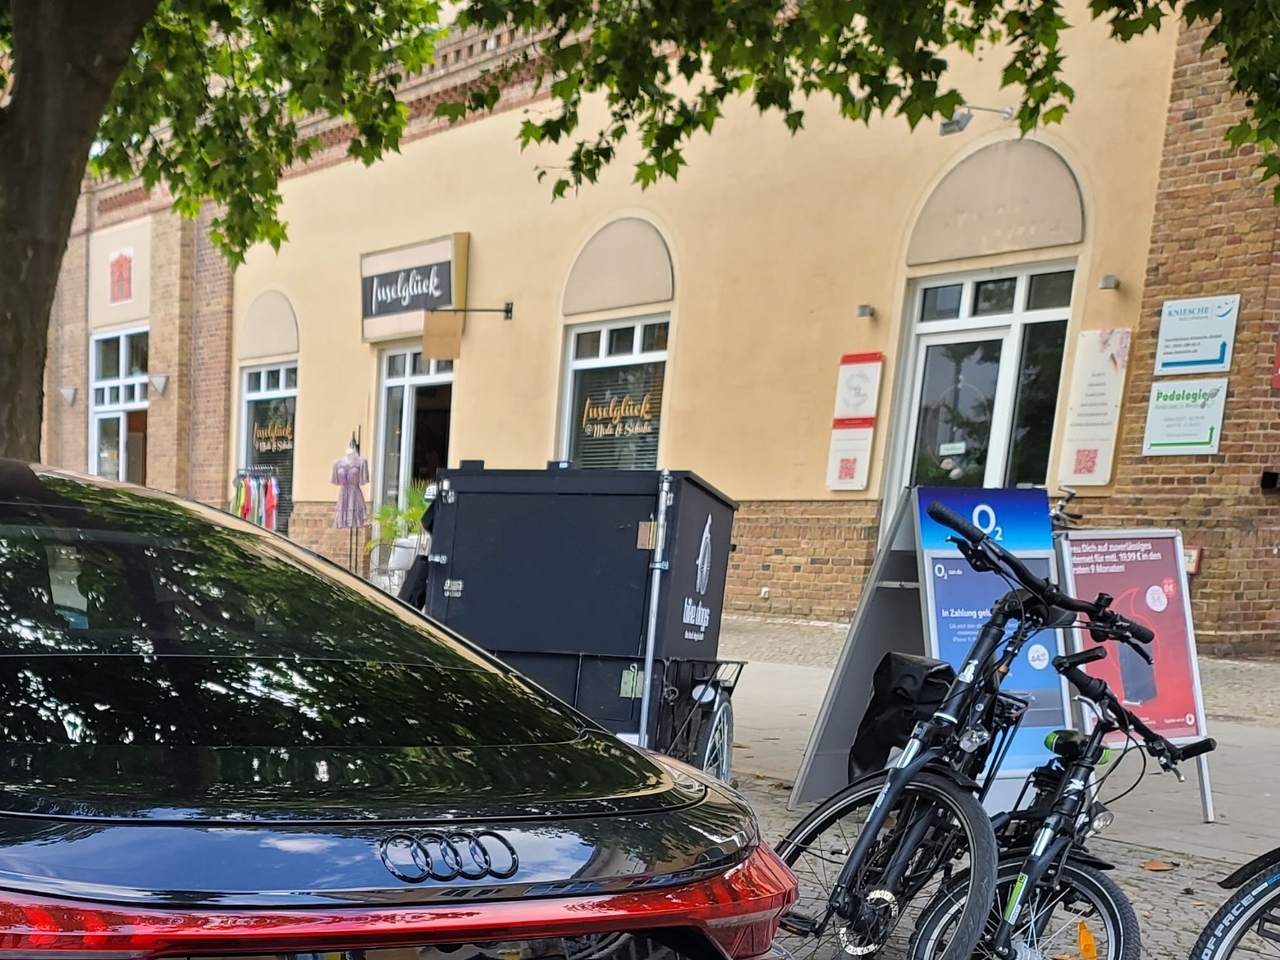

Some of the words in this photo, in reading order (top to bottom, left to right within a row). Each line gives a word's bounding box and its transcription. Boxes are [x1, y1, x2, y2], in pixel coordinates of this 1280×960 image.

[372, 265, 443, 315] Inselglück
[1168, 306, 1209, 317] KNIESCHE
[1156, 388, 1209, 403] Podologie
[583, 393, 652, 428] Inselglück
[949, 609, 977, 619] Zahlung
[1214, 895, 1255, 938] PACE
